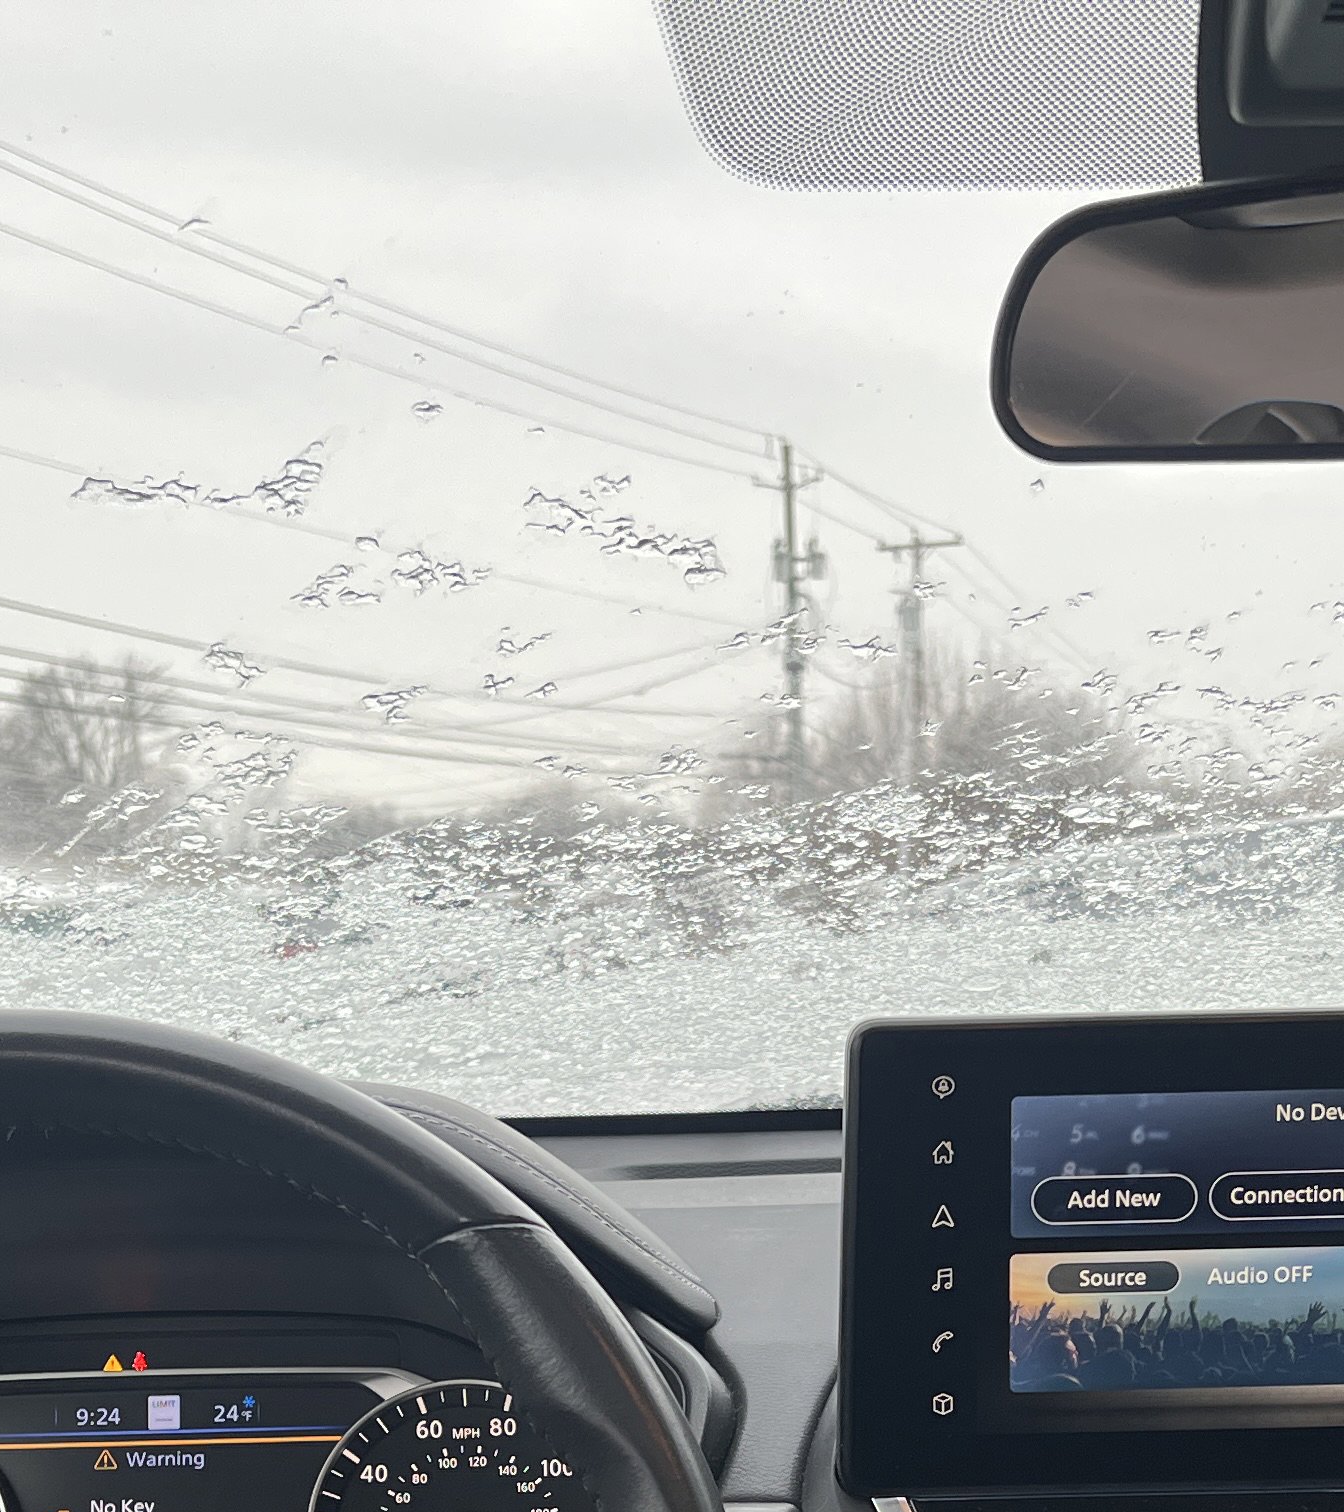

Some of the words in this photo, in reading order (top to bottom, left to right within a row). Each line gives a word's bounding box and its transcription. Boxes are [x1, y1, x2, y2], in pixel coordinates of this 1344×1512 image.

[1275, 1103, 1305, 1122] No
[1067, 1189, 1109, 1209] Add
[1115, 1188, 1161, 1208] New
[1078, 1268, 1147, 1288] Source
[1206, 1266, 1268, 1286] Audio
[1274, 1265, 1314, 1284] OFF
[76, 1407, 121, 1426] 9:24
[415, 1420, 443, 1439] 60
[452, 1427, 480, 1440] MPH
[489, 1418, 517, 1437] 80
[126, 1451, 205, 1470] Warning
[438, 1457, 458, 1469] 100
[468, 1456, 487, 1468] 120
[360, 1464, 388, 1483] 40
[411, 1473, 428, 1485] 80
[498, 1465, 518, 1477] 140
[516, 1481, 536, 1493] 160
[395, 1492, 411, 1504] 60
